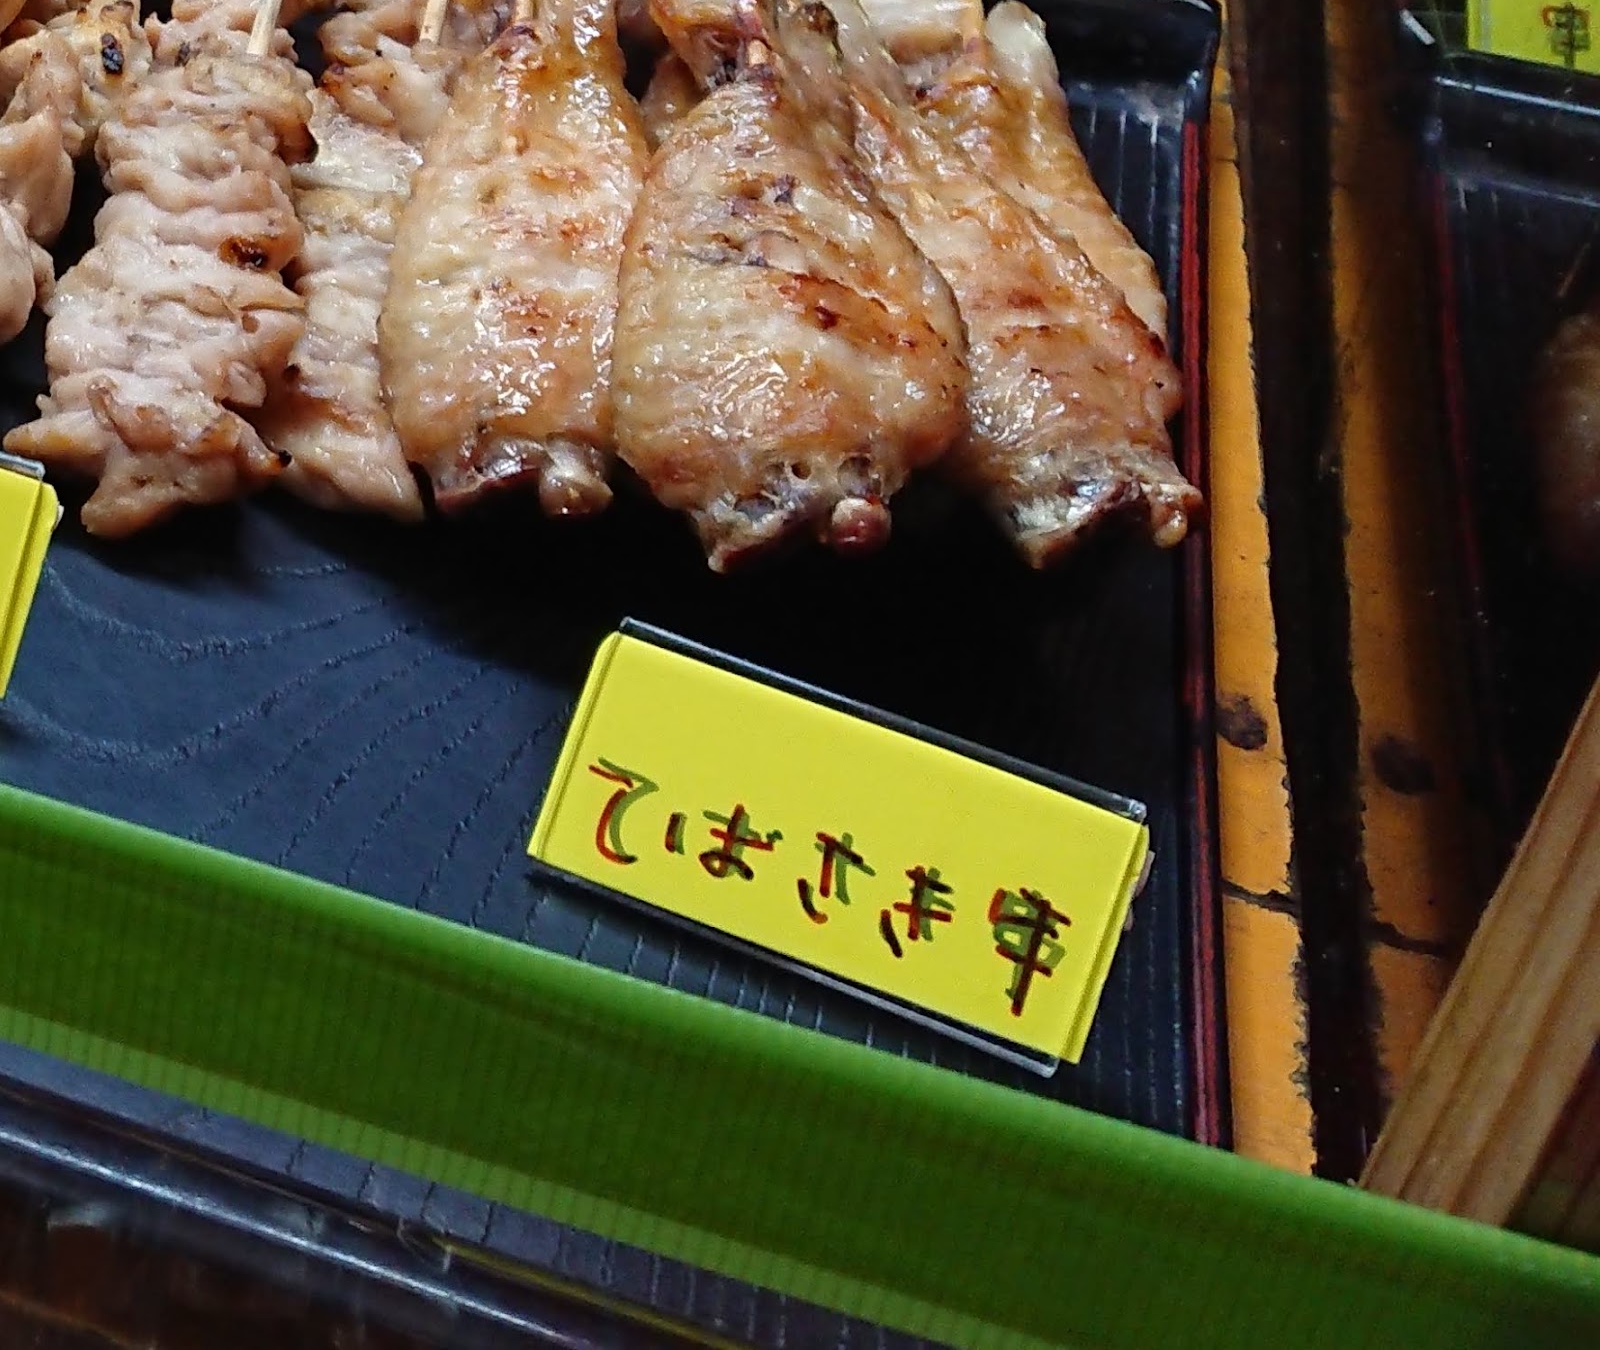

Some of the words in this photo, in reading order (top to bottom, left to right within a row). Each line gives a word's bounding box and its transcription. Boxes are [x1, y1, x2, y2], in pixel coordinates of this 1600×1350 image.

[587, 756, 1074, 1018] てばさき串
